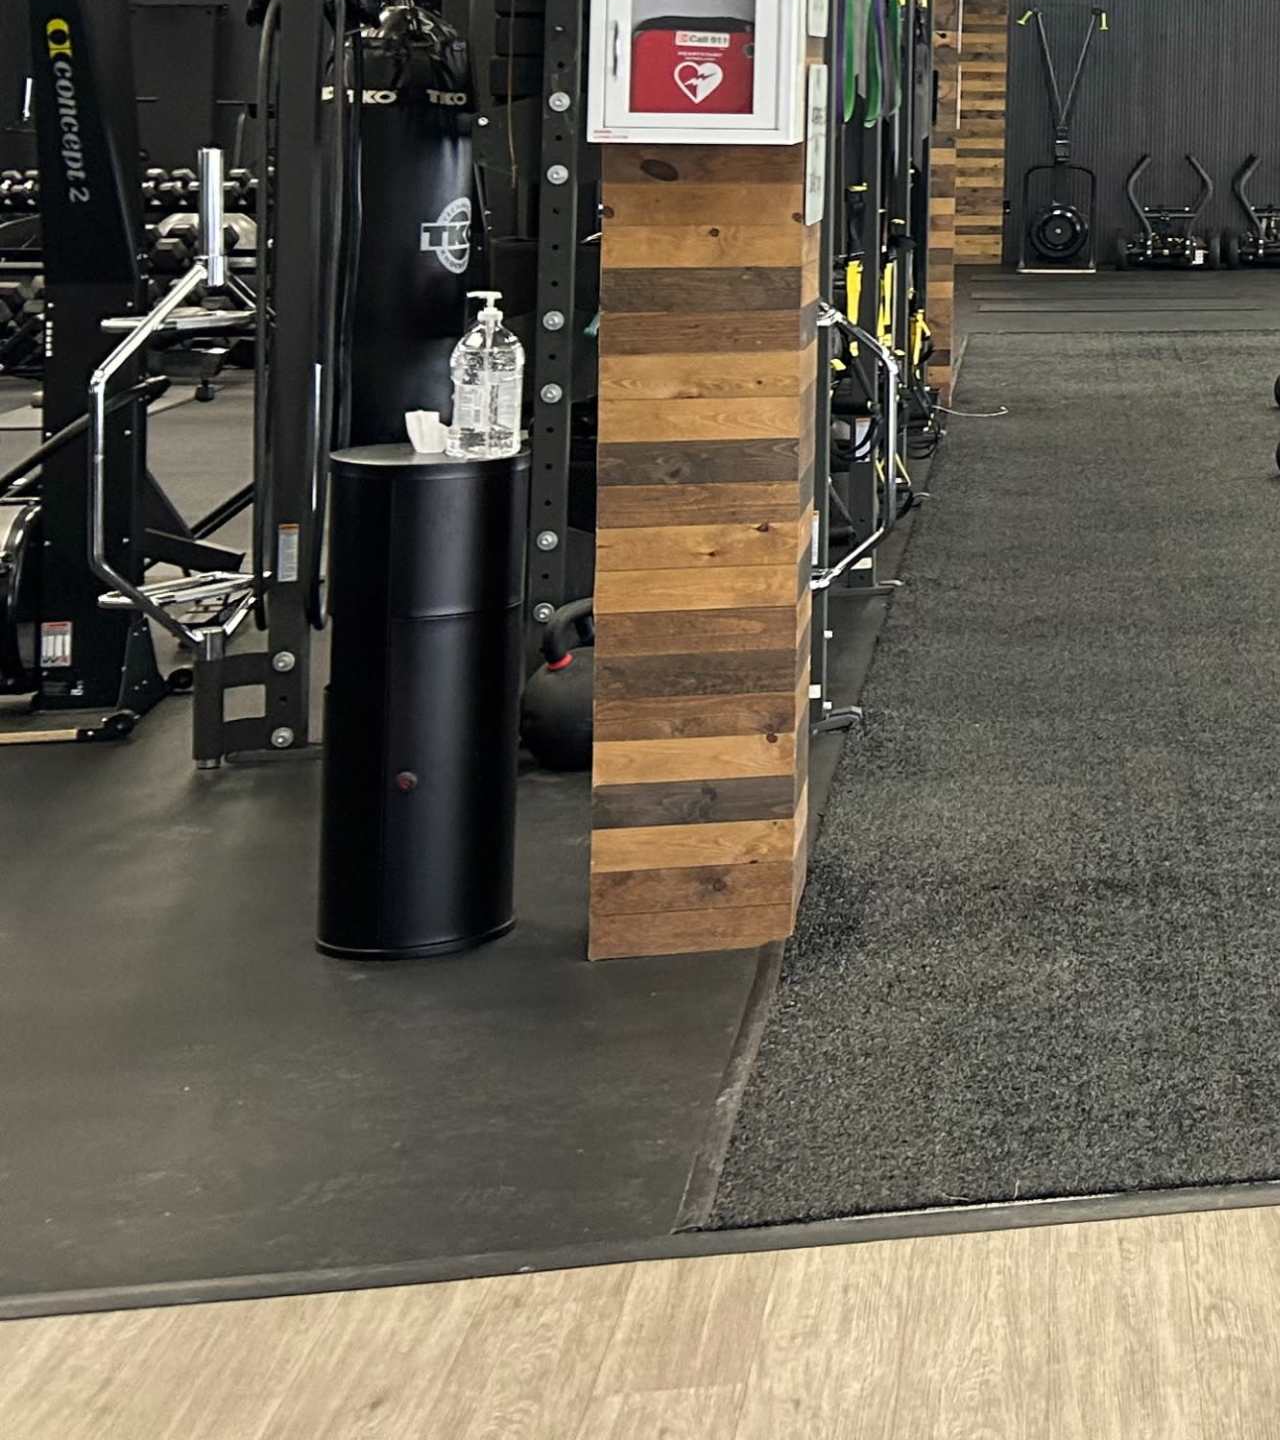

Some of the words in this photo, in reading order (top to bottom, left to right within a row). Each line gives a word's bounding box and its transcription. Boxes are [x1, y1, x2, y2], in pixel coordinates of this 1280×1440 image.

[53, 60, 86, 181] concept
[69, 187, 90, 203] 2
[421, 224, 470, 250] TK
